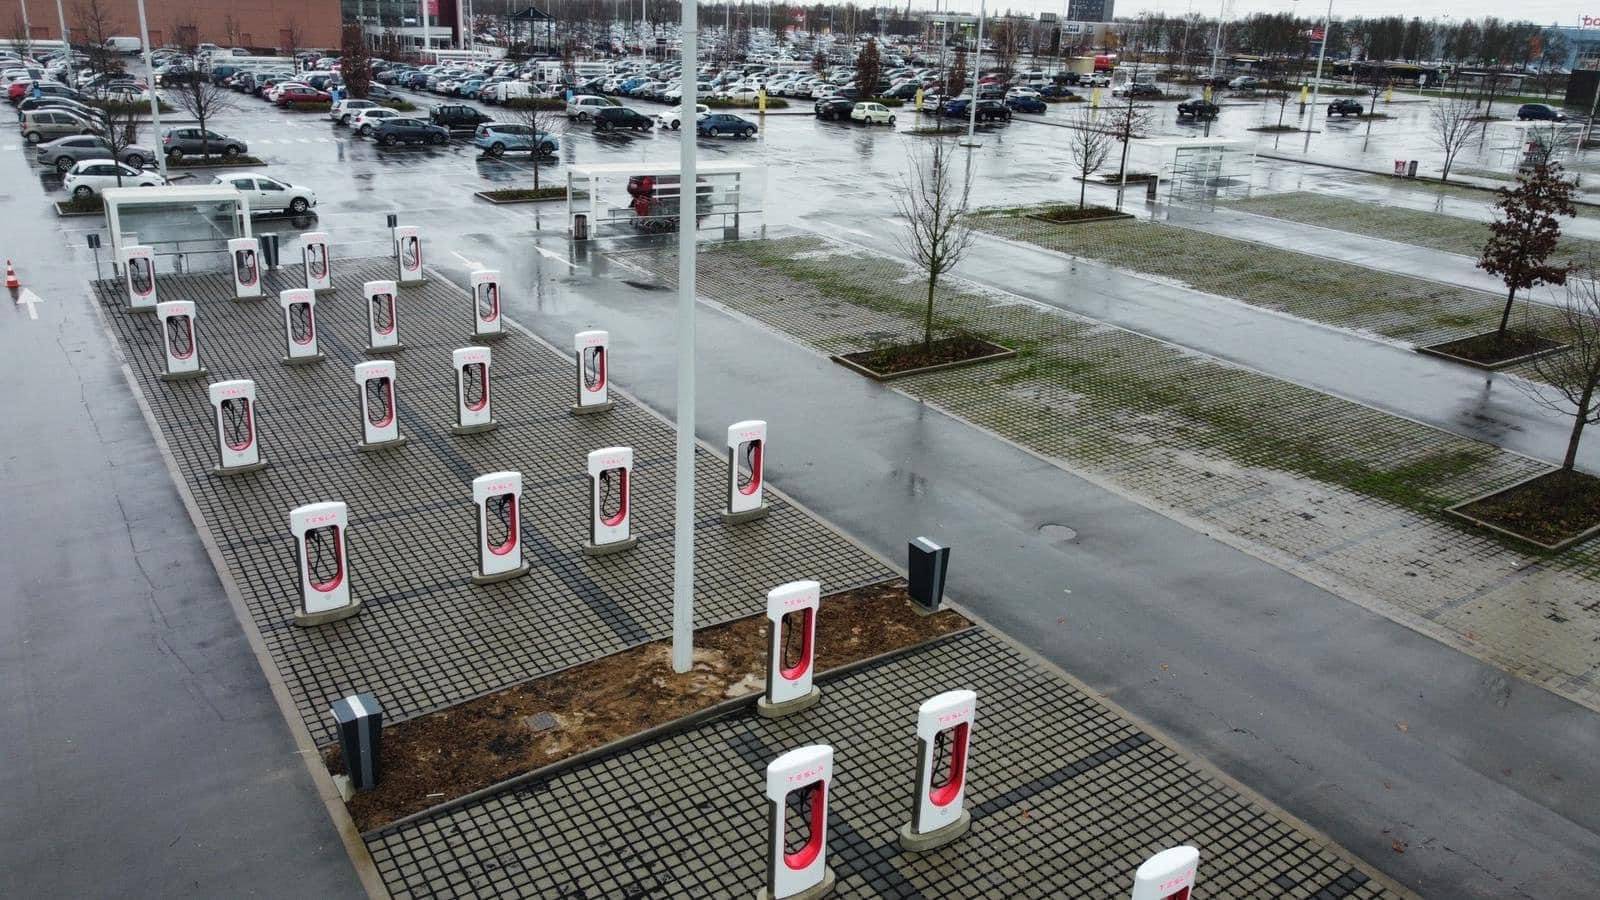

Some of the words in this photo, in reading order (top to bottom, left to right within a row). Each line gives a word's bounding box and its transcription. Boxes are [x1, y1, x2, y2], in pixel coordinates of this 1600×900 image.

[487, 482, 513, 491] TESLA
[305, 512, 337, 523] TESLA
[784, 594, 812, 605] TESLA
[938, 706, 970, 723] TESLA
[789, 764, 824, 780] TESLA
[1159, 868, 1194, 889] TESLA
